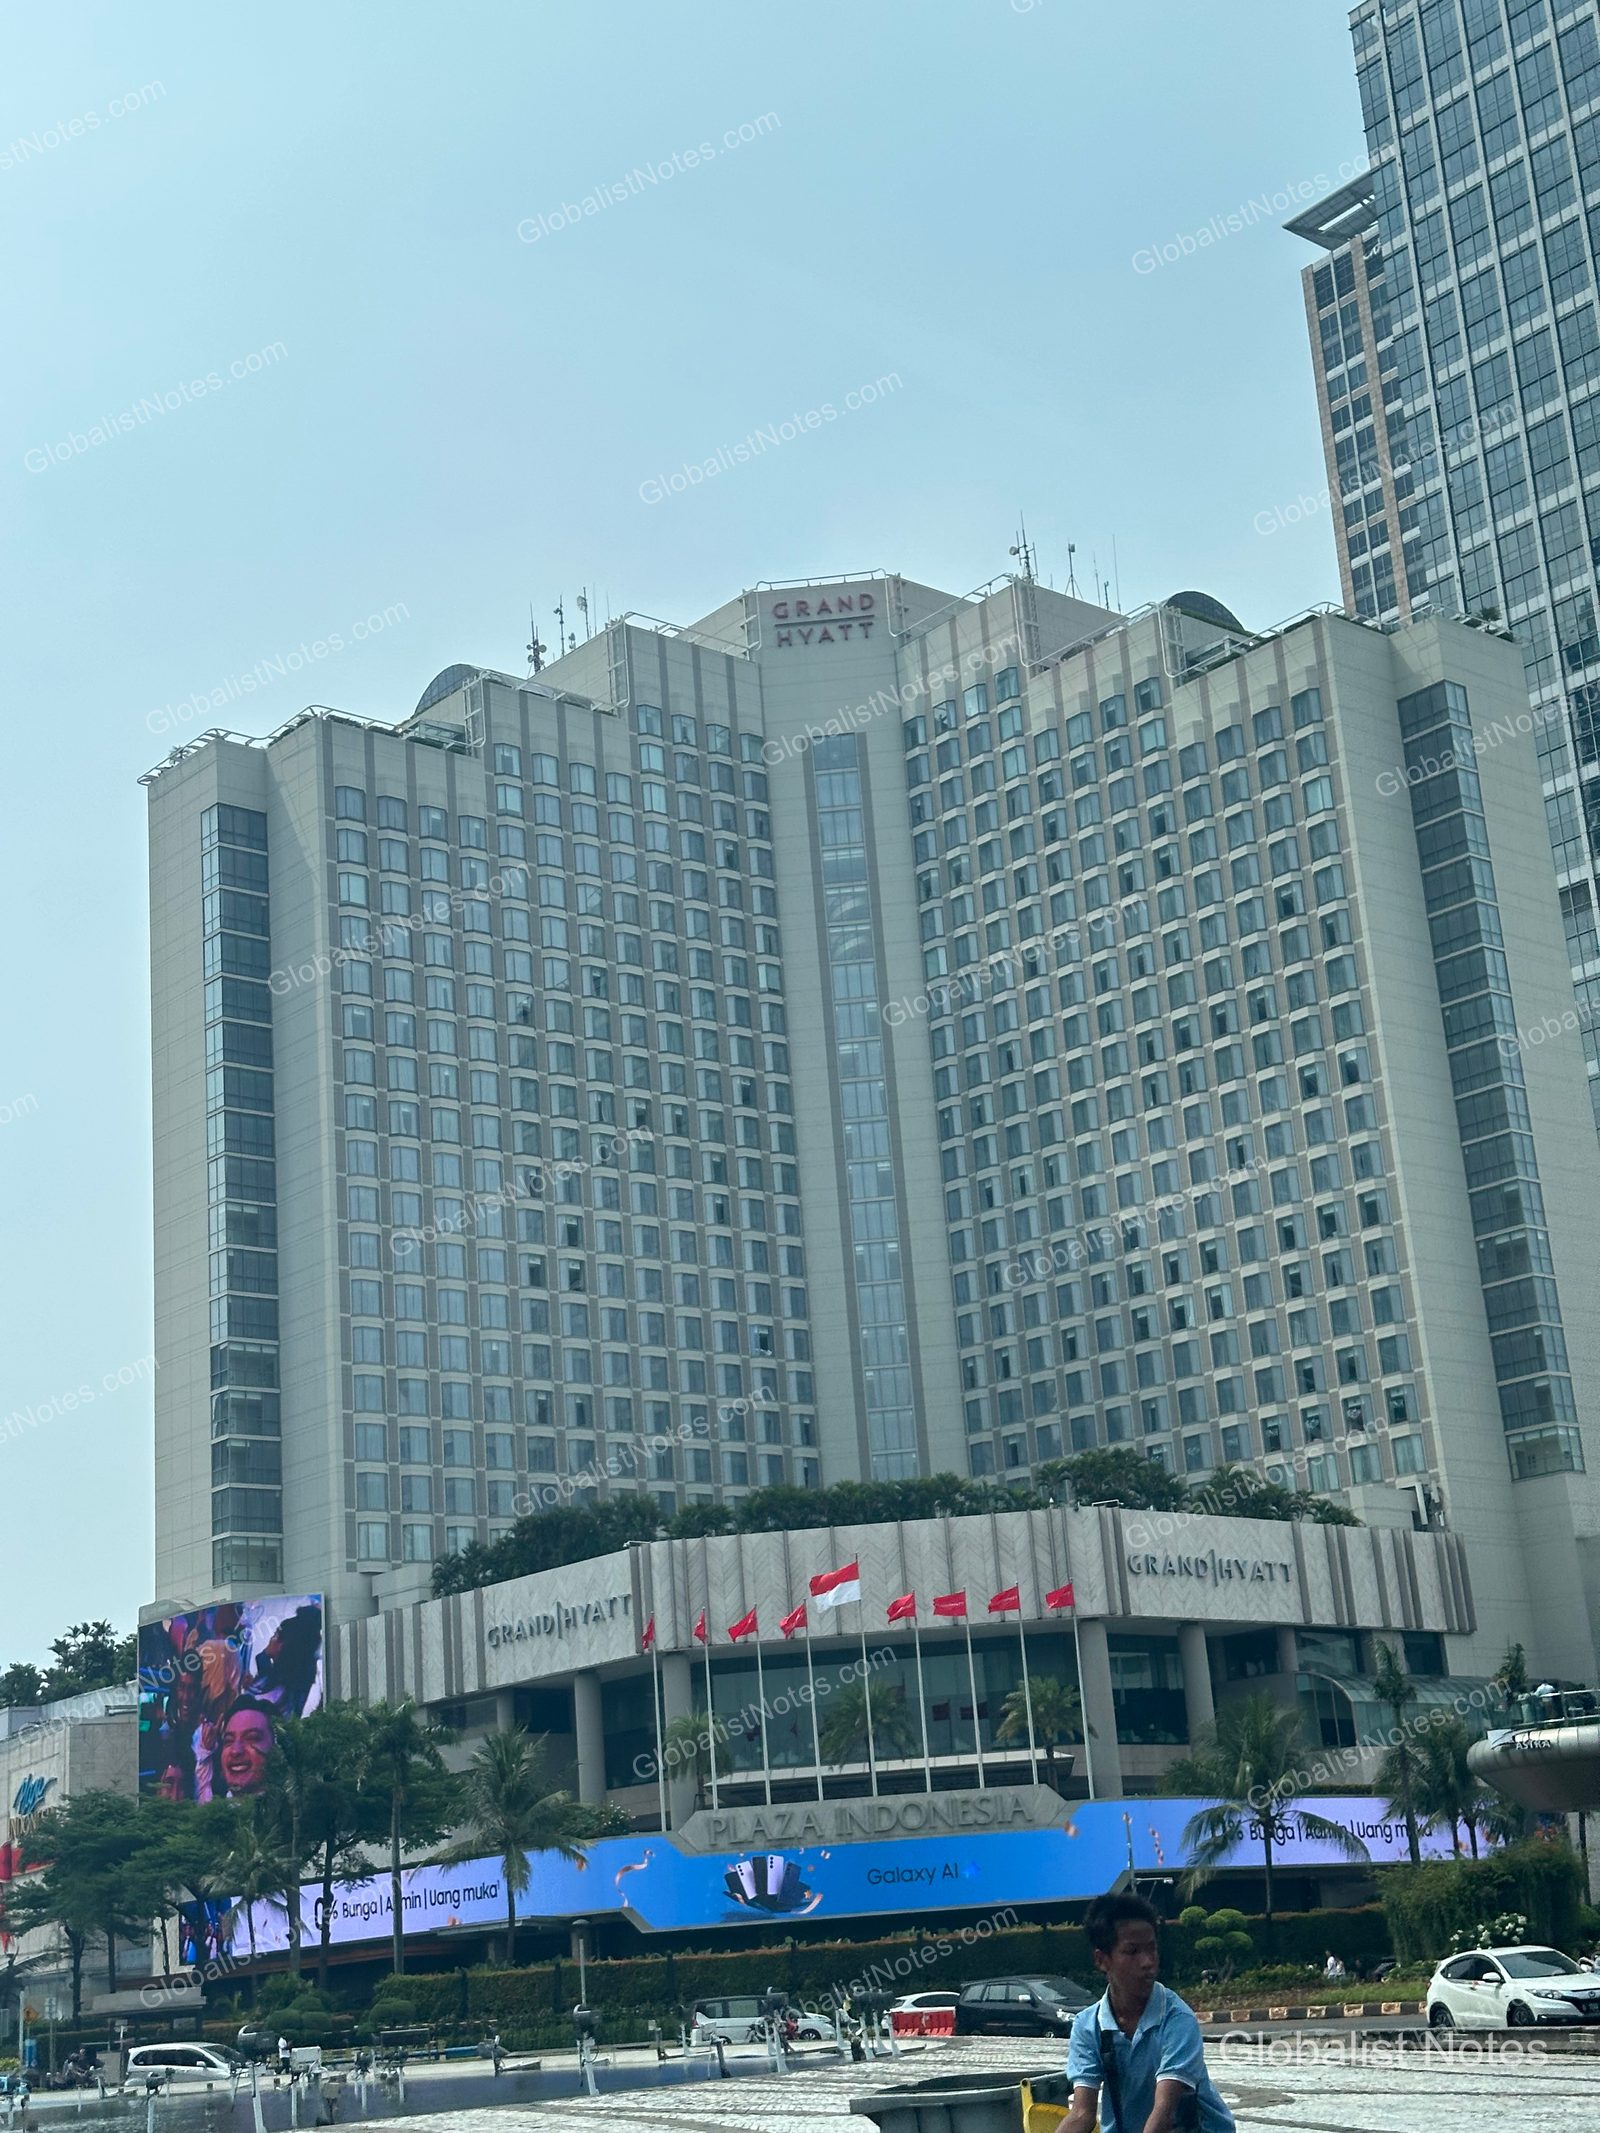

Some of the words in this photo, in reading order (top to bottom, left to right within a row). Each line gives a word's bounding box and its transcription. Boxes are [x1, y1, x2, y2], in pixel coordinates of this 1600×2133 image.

[772, 593, 875, 619] GRAND
[777, 622, 873, 648] HYATT
[1127, 1554, 1208, 1579] GRAND
[1218, 1557, 1292, 1582] HYATT
[1516, 1739, 1551, 1750] ASTRA
[707, 1809, 825, 1846] PLAZA
[834, 1793, 1033, 1837] INDONESIA
[1356, 1821, 1393, 1844] Uang
[867, 1866, 937, 1885] Galaxy
[942, 1862, 959, 1879] AI
[342, 1900, 378, 1921] Bunga
[385, 1890, 422, 1912] Amin
[429, 1888, 461, 1909] Uang
